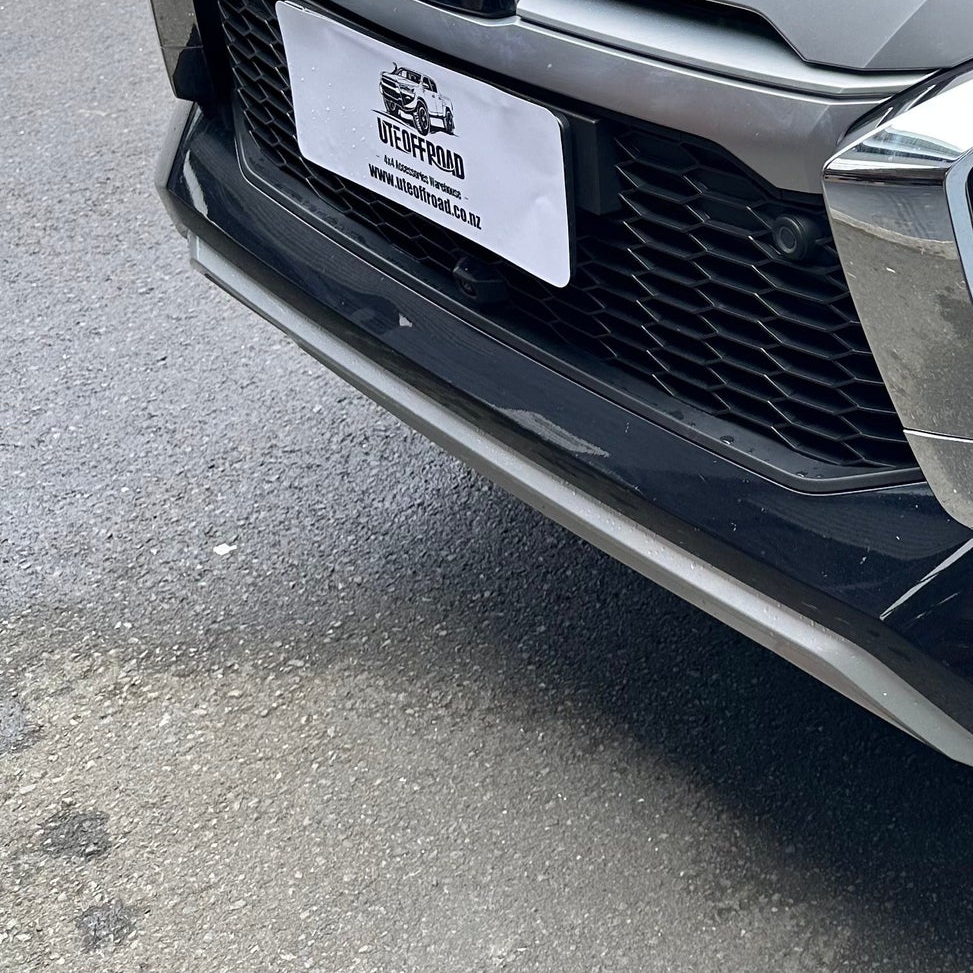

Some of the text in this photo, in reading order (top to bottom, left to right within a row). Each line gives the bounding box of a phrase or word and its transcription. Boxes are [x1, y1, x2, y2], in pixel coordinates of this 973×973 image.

[368, 163, 482, 230] www.uteoffroad.co.nz
[383, 154, 462, 200] 4x4 Accessories Warehouse
